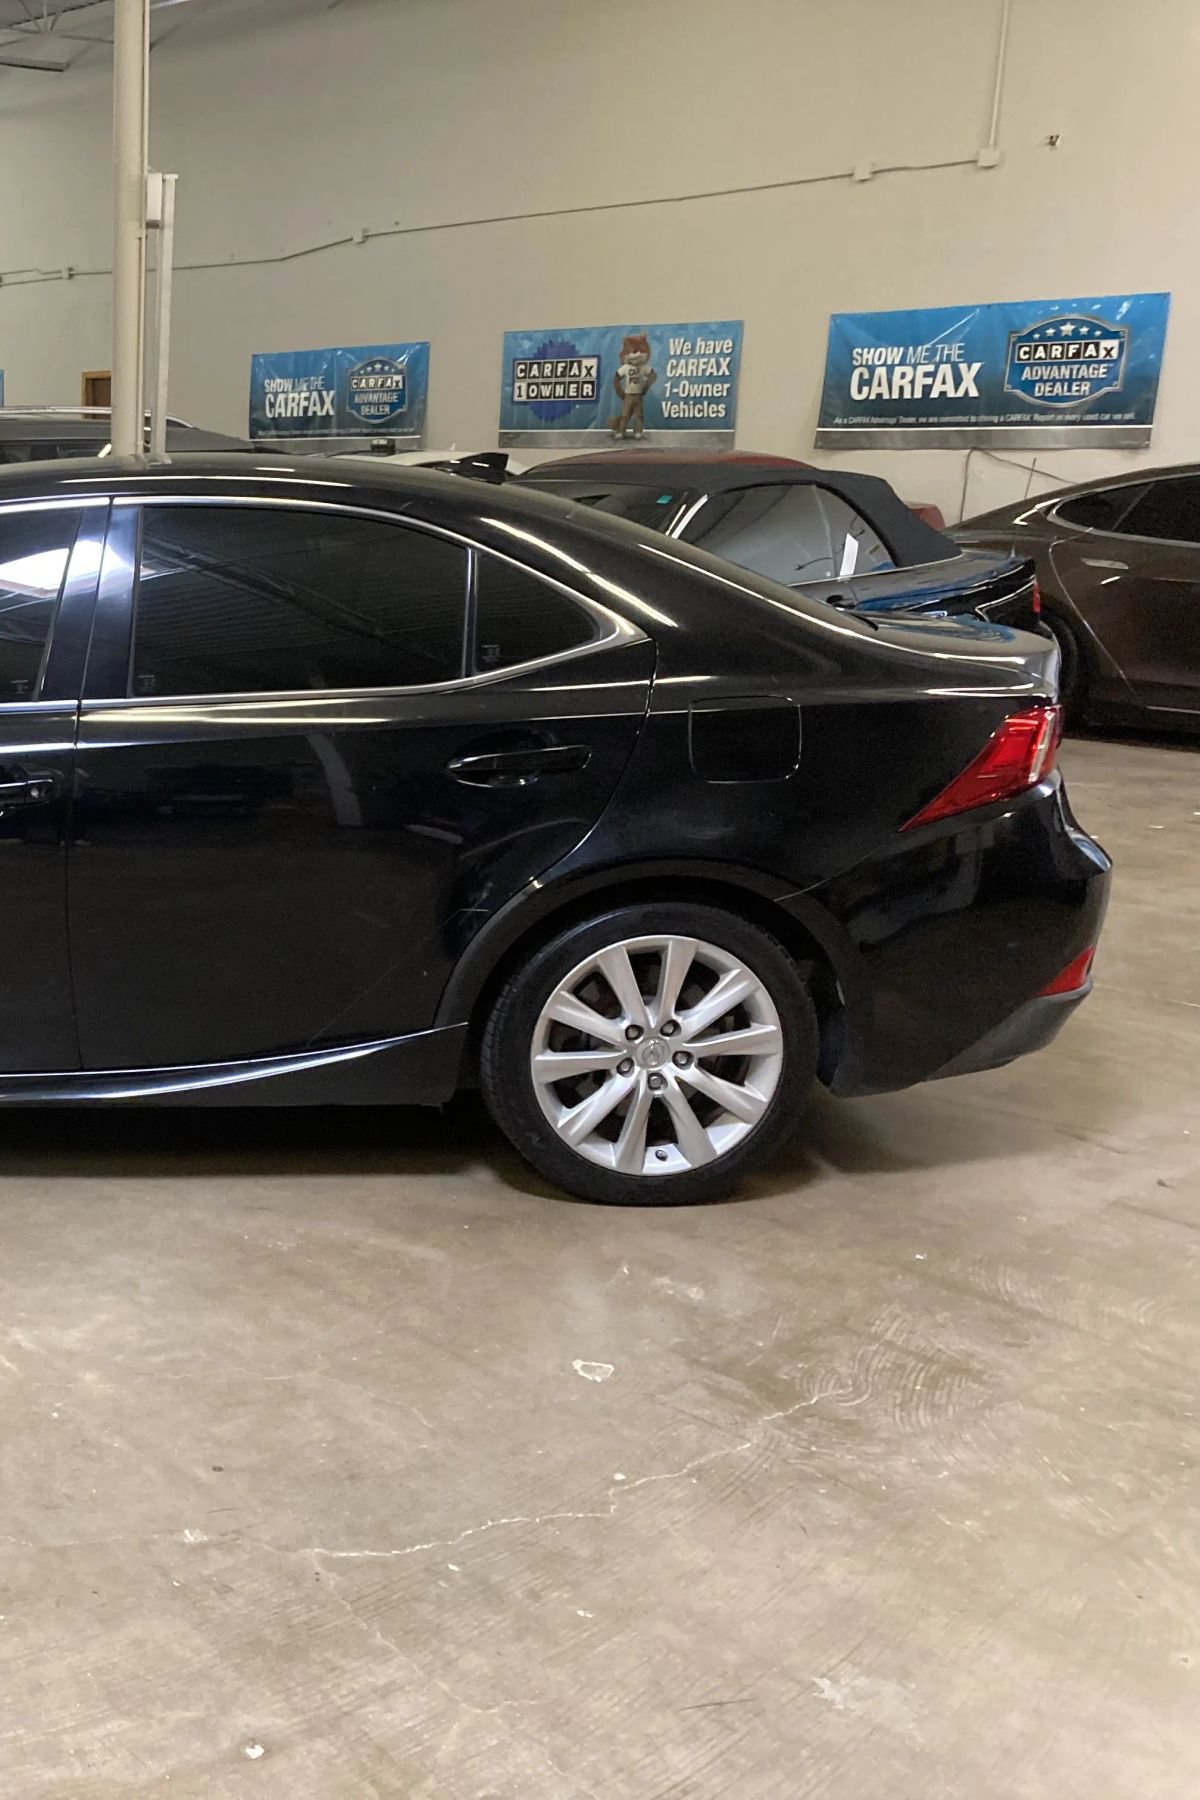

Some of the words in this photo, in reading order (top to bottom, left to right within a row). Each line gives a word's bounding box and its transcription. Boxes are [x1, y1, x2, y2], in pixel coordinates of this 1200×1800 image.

[669, 339, 692, 355] We
[696, 337, 733, 355] have
[852, 347, 903, 367] SHOW
[906, 346, 934, 365] ME
[937, 343, 965, 362] THE
[1016, 341, 1117, 361] CARFAX
[515, 360, 595, 379] CARFAX
[666, 357, 731, 377] CARFAX
[1021, 364, 1108, 380] ADVANTAGE
[264, 378, 292, 393] SHOW
[351, 376, 402, 390] CARFAX
[664, 380, 731, 399] 1-Owner
[849, 362, 981, 400] CARFAX
[1034, 382, 1090, 397] DEALER
[265, 391, 335, 418] CARFAX
[354, 392, 398, 403] ADVANTAGE
[360, 405, 390, 416] DEALER
[662, 401, 726, 418] Vehicles
